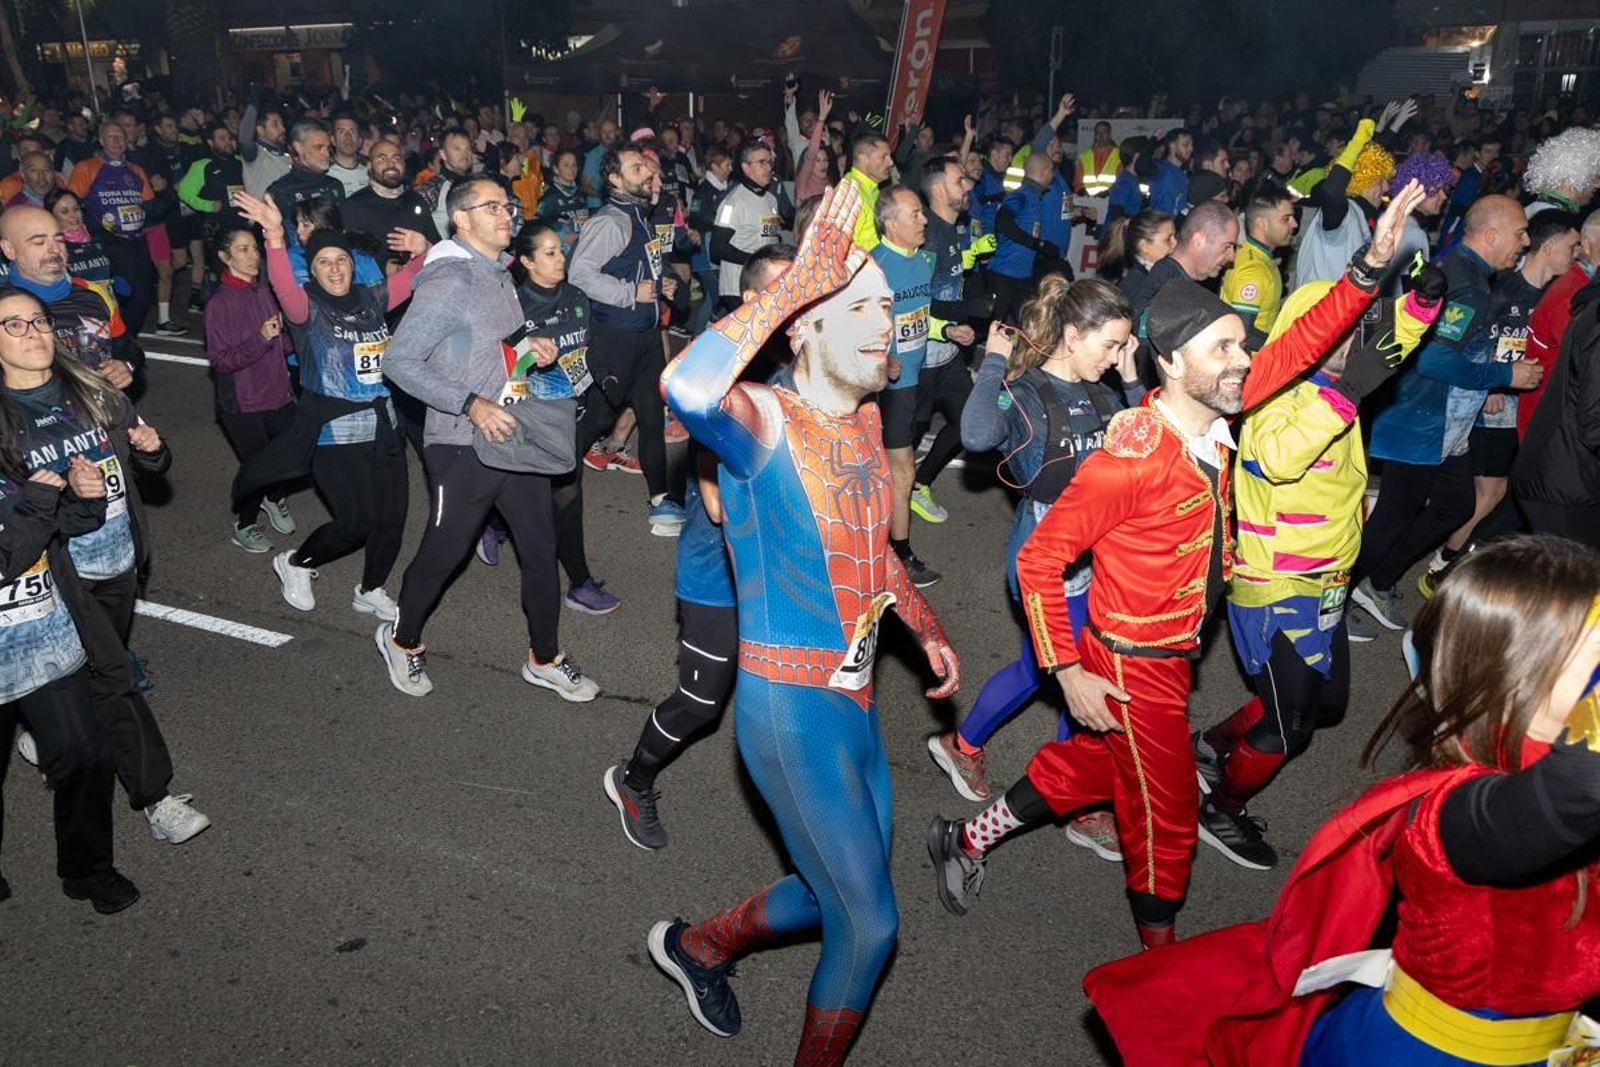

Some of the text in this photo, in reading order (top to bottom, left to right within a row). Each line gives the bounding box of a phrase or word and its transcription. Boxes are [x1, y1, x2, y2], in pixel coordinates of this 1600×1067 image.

[1501, 326, 1529, 339] SAN
[360, 354, 381, 369] 81
[106, 474, 121, 493] 9
